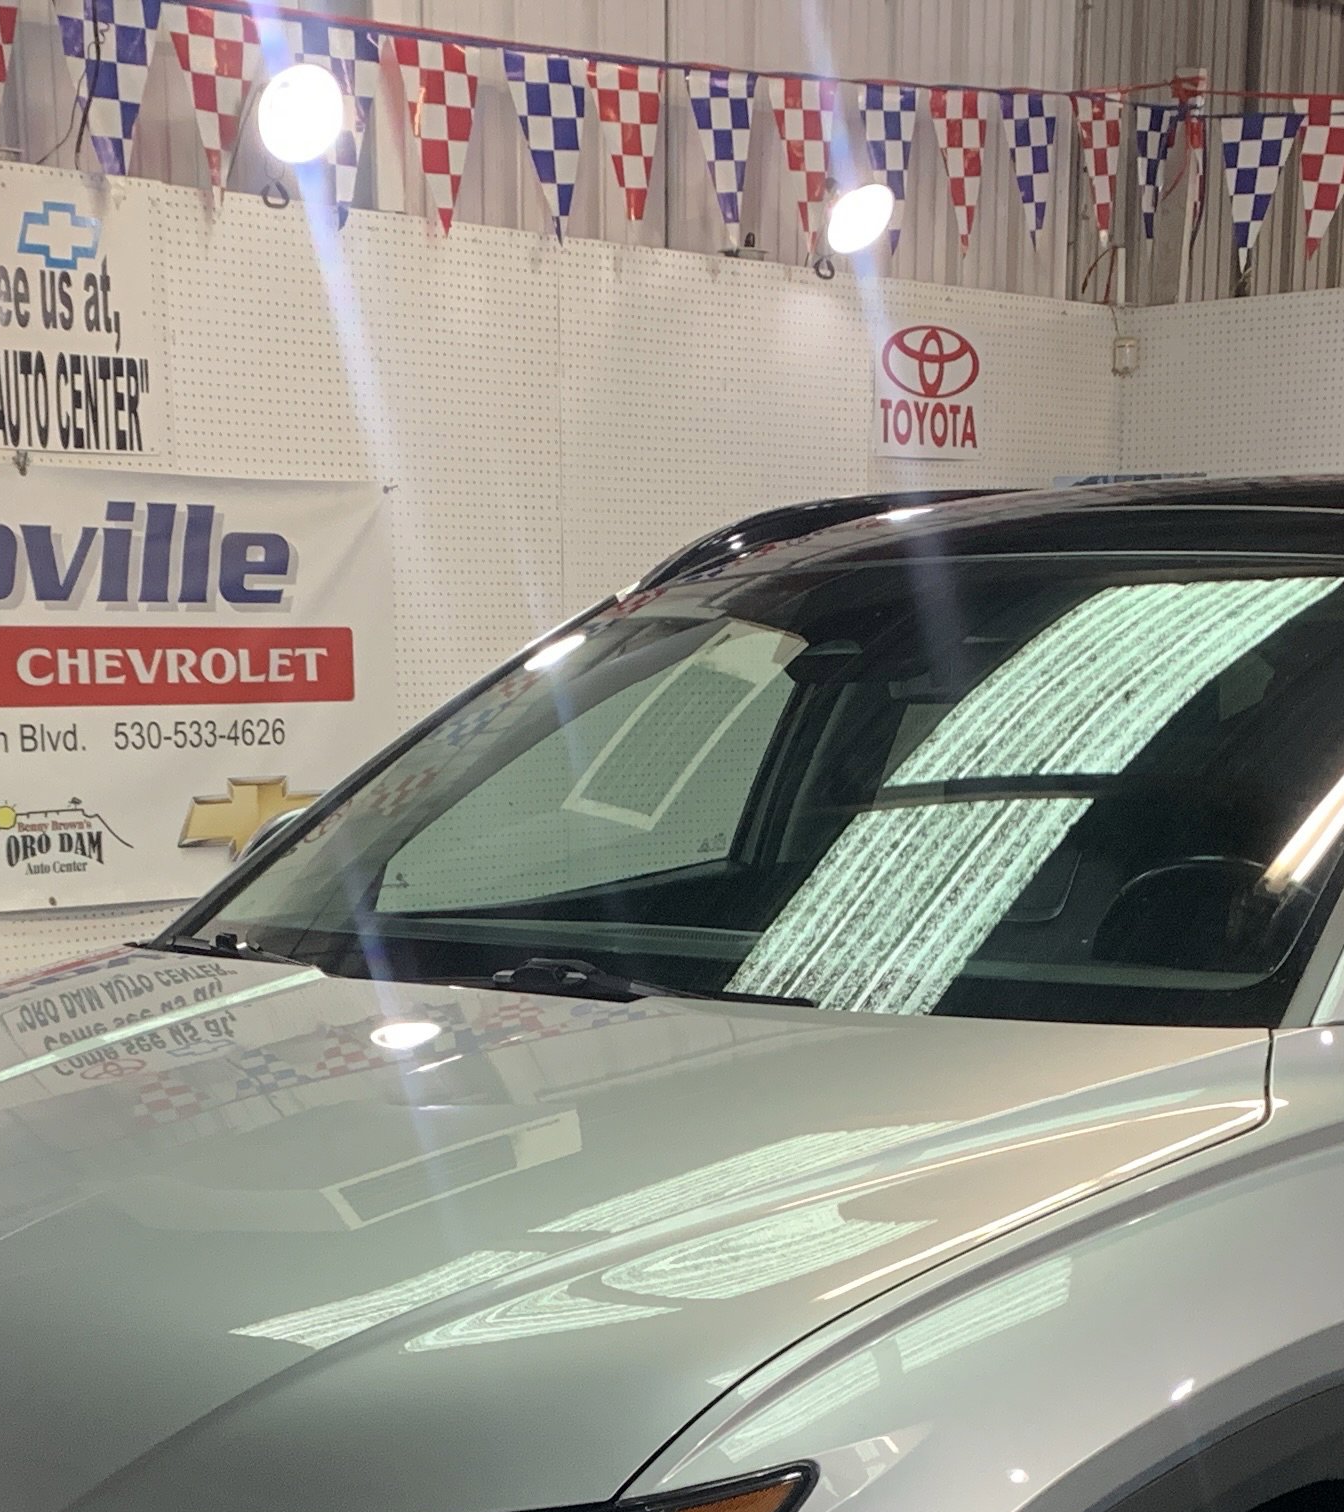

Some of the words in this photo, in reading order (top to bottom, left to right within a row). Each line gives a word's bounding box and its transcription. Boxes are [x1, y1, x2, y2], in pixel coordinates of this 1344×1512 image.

[40, 269, 74, 331] us
[84, 254, 121, 353] at,
[56, 351, 150, 452] CENTER"
[880, 398, 978, 449] TOYOTA
[16, 647, 329, 687] CHEVROLET
[19, 724, 88, 754] Blvd.
[113, 718, 287, 751] 530-533-4626
[7, 833, 52, 868] ORO
[59, 831, 104, 864] DAM
[25, 862, 51, 875] Auto
[52, 861, 88, 874] Center
